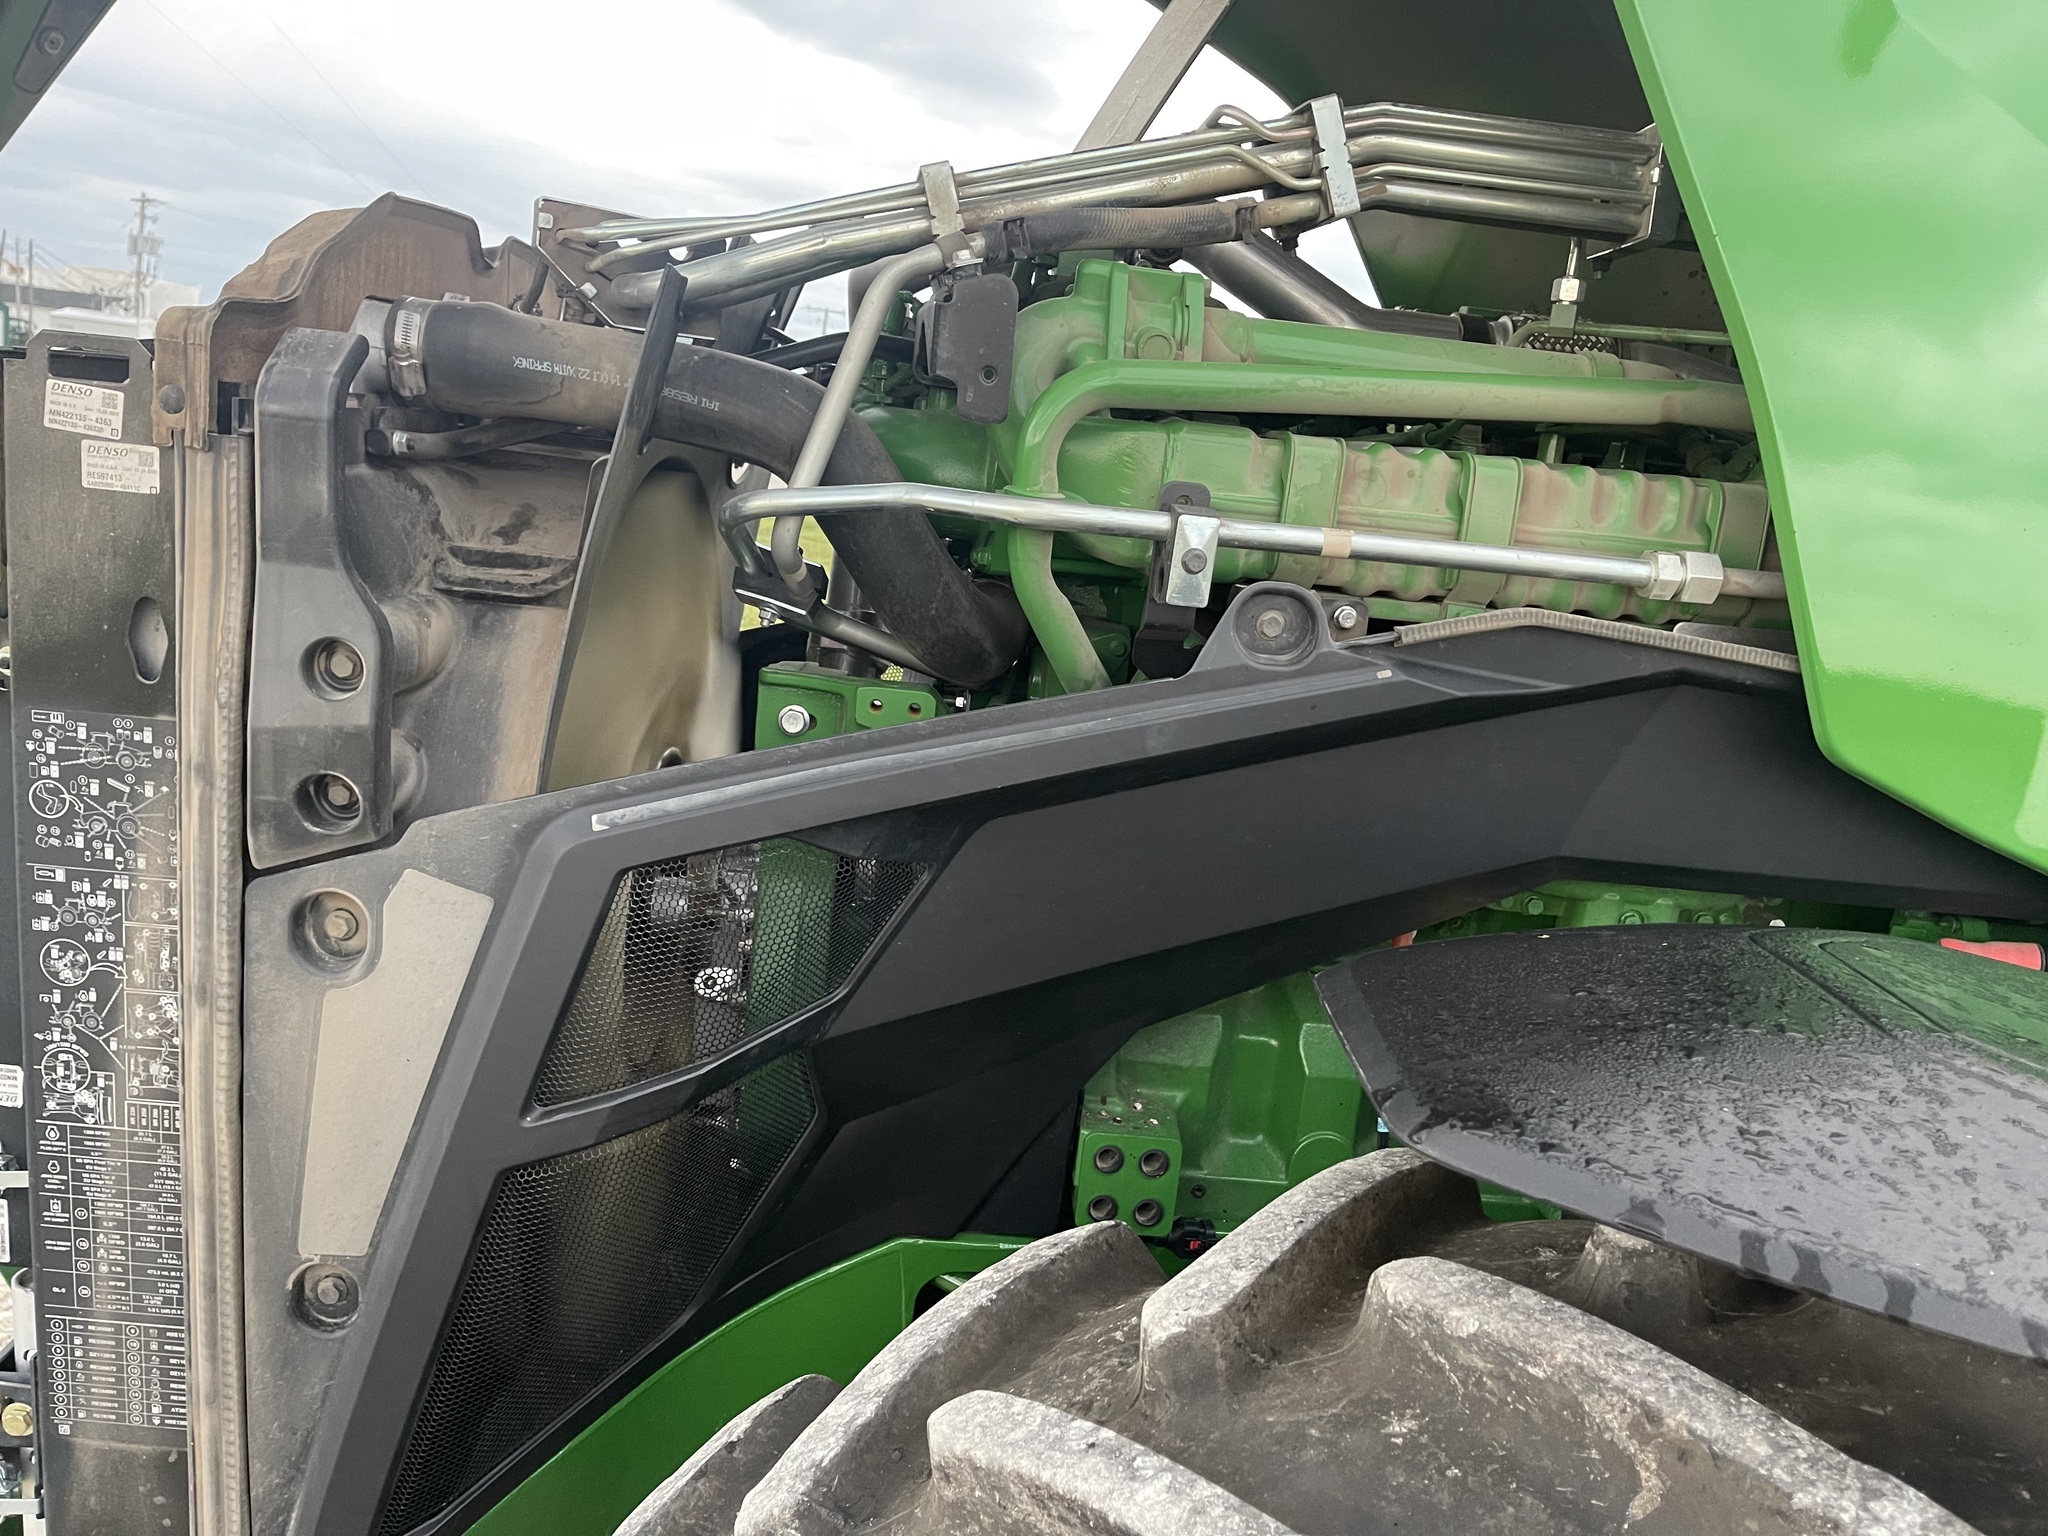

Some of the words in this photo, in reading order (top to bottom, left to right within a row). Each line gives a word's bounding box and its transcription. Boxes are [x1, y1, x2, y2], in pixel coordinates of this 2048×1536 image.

[578, 366, 591, 380] 22
[51, 382, 93, 397] DENSO
[88, 445, 129, 457] DENSO
[87, 471, 122, 482] RE597413
